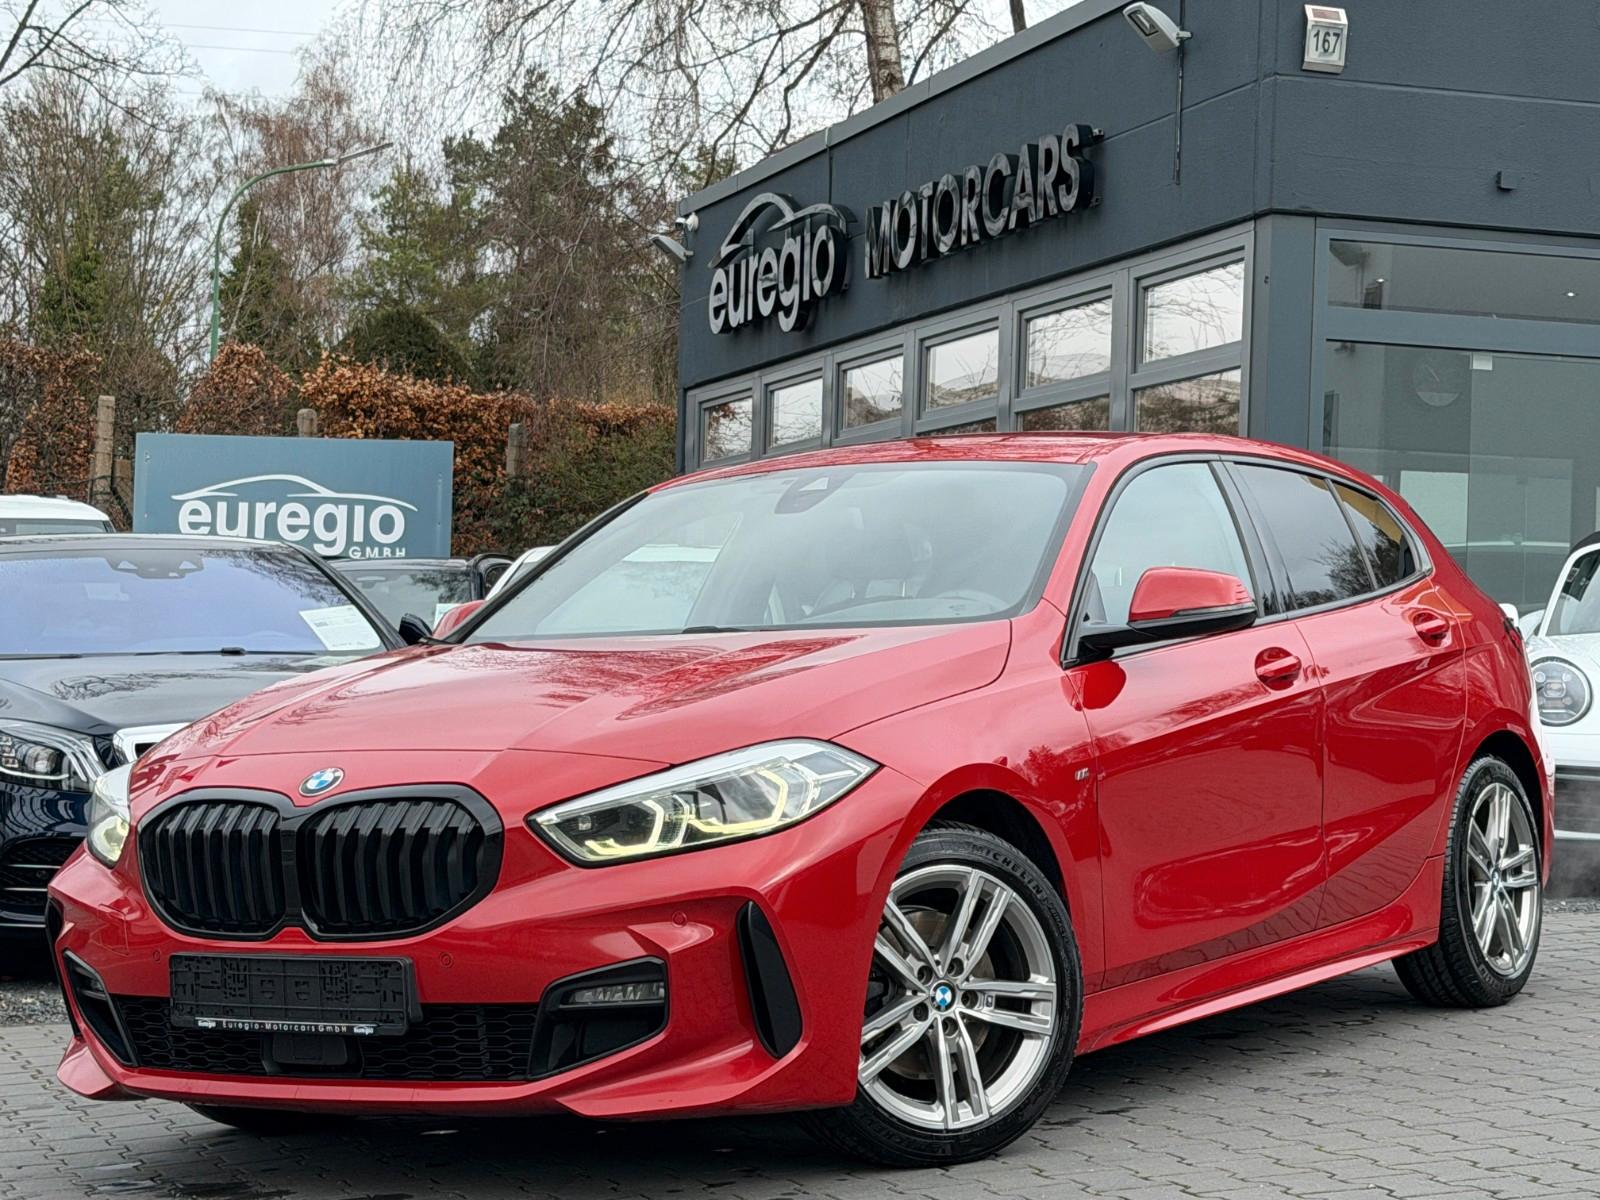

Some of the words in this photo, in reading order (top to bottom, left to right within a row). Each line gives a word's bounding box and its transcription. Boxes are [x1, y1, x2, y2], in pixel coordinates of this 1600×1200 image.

[1313, 29, 1341, 53] 167
[708, 222, 835, 334] euregio
[864, 123, 1081, 279] MOTORCARS
[178, 500, 405, 556] euregio
[972, 844, 1043, 896] MICHELIN
